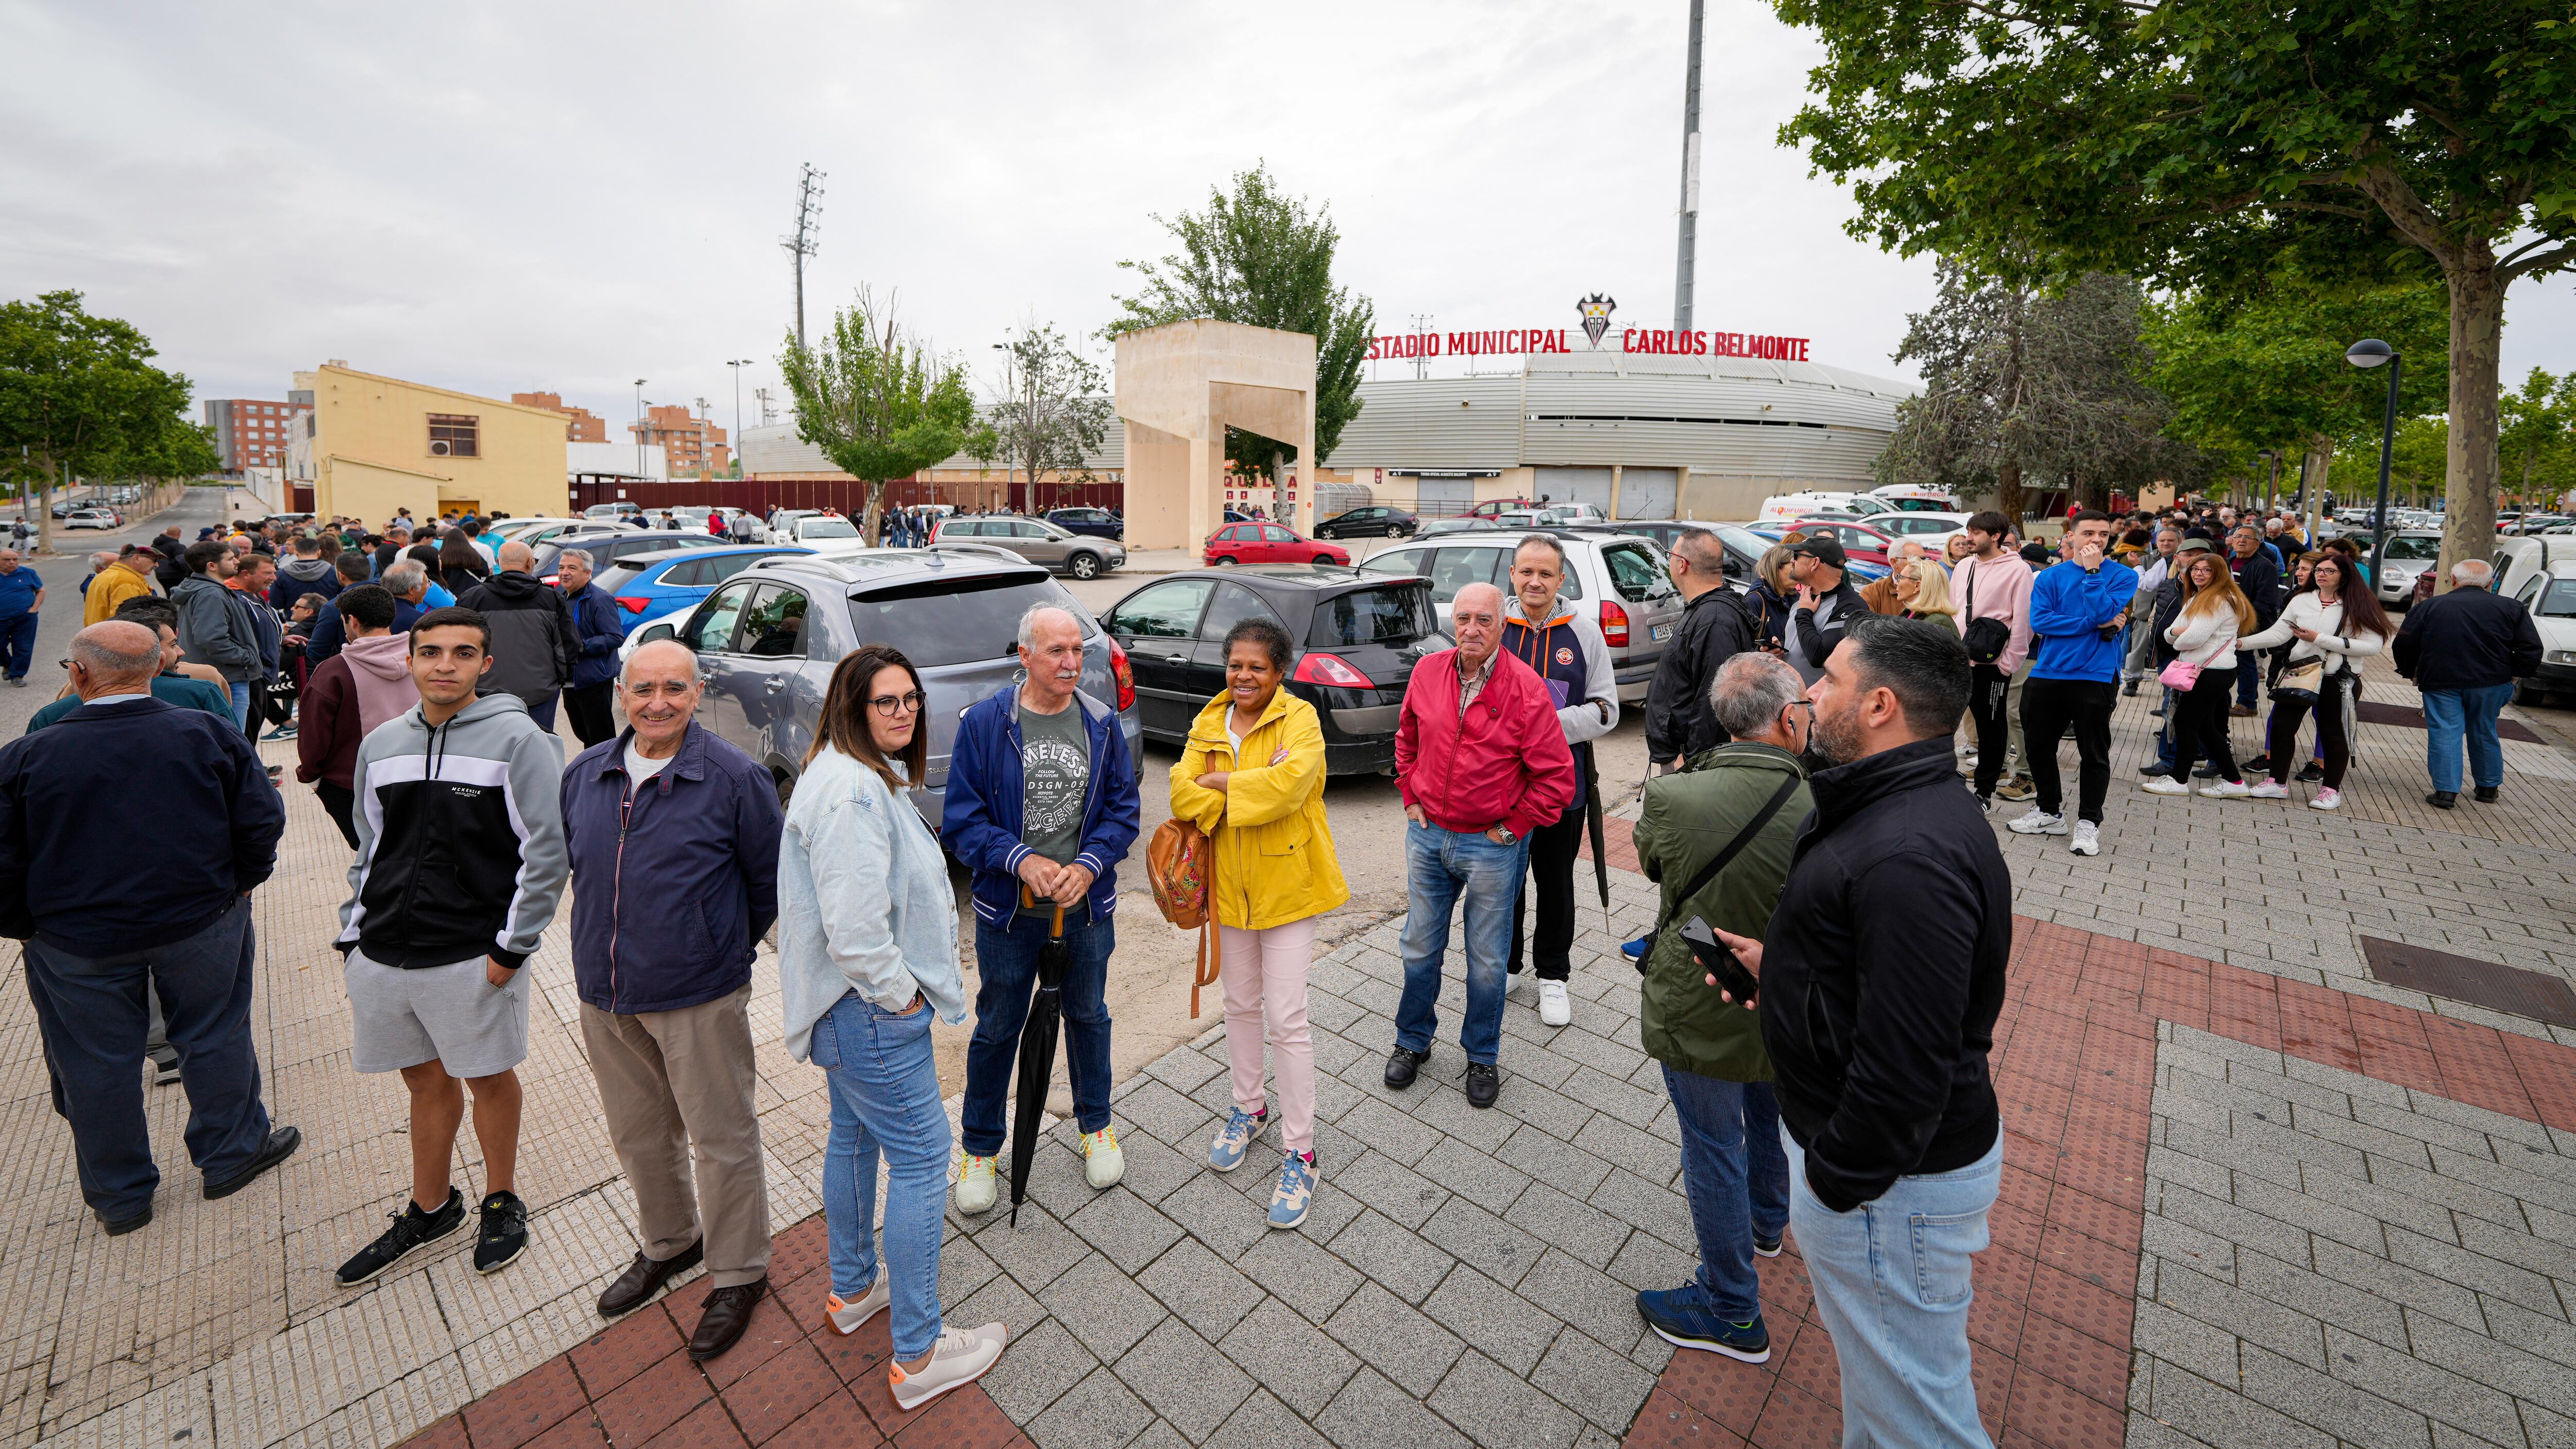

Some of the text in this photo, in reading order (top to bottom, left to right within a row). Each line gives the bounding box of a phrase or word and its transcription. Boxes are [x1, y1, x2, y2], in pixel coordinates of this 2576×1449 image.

[1448, 330, 1570, 355] MUNICIPAL
[1623, 329, 1810, 362] CARLOS BELMONTE
[1770, 507, 1813, 515] ALQUIFURGO
[1655, 625, 1669, 637] 1346
[928, 765, 951, 774] SSANG
[451, 787, 481, 795] MCKENZIE
[1023, 790, 1082, 828] NCEPT
